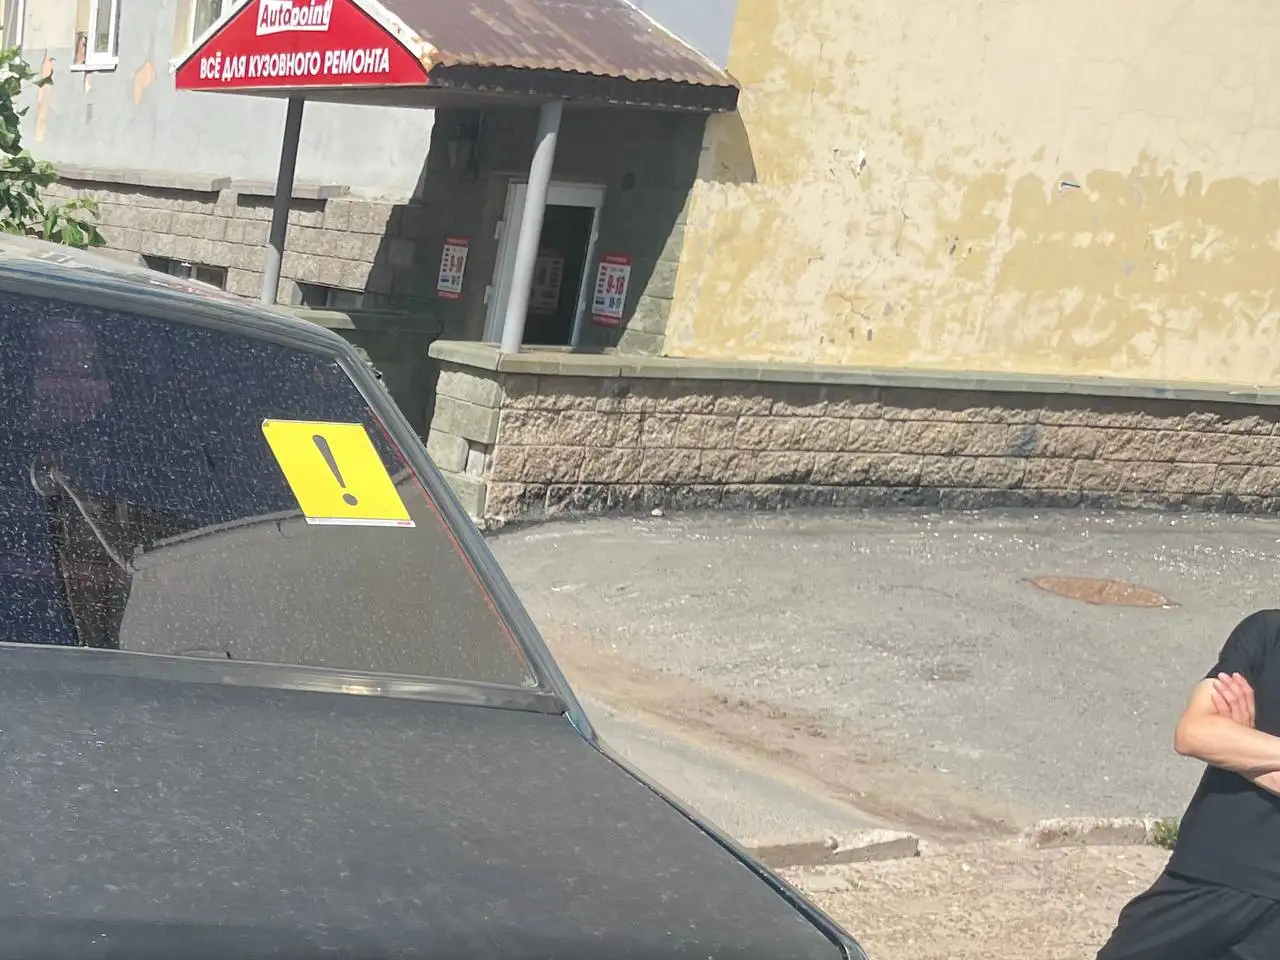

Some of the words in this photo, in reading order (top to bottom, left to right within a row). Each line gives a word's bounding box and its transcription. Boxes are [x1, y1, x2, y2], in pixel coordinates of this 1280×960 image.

[260, 0, 331, 28] Autopoint
[199, 52, 221, 80] ВСЁ
[222, 57, 245, 82] ДЛЯ
[248, 50, 320, 79] КУЗОВНОГО
[323, 47, 390, 75] РЕМОНТА
